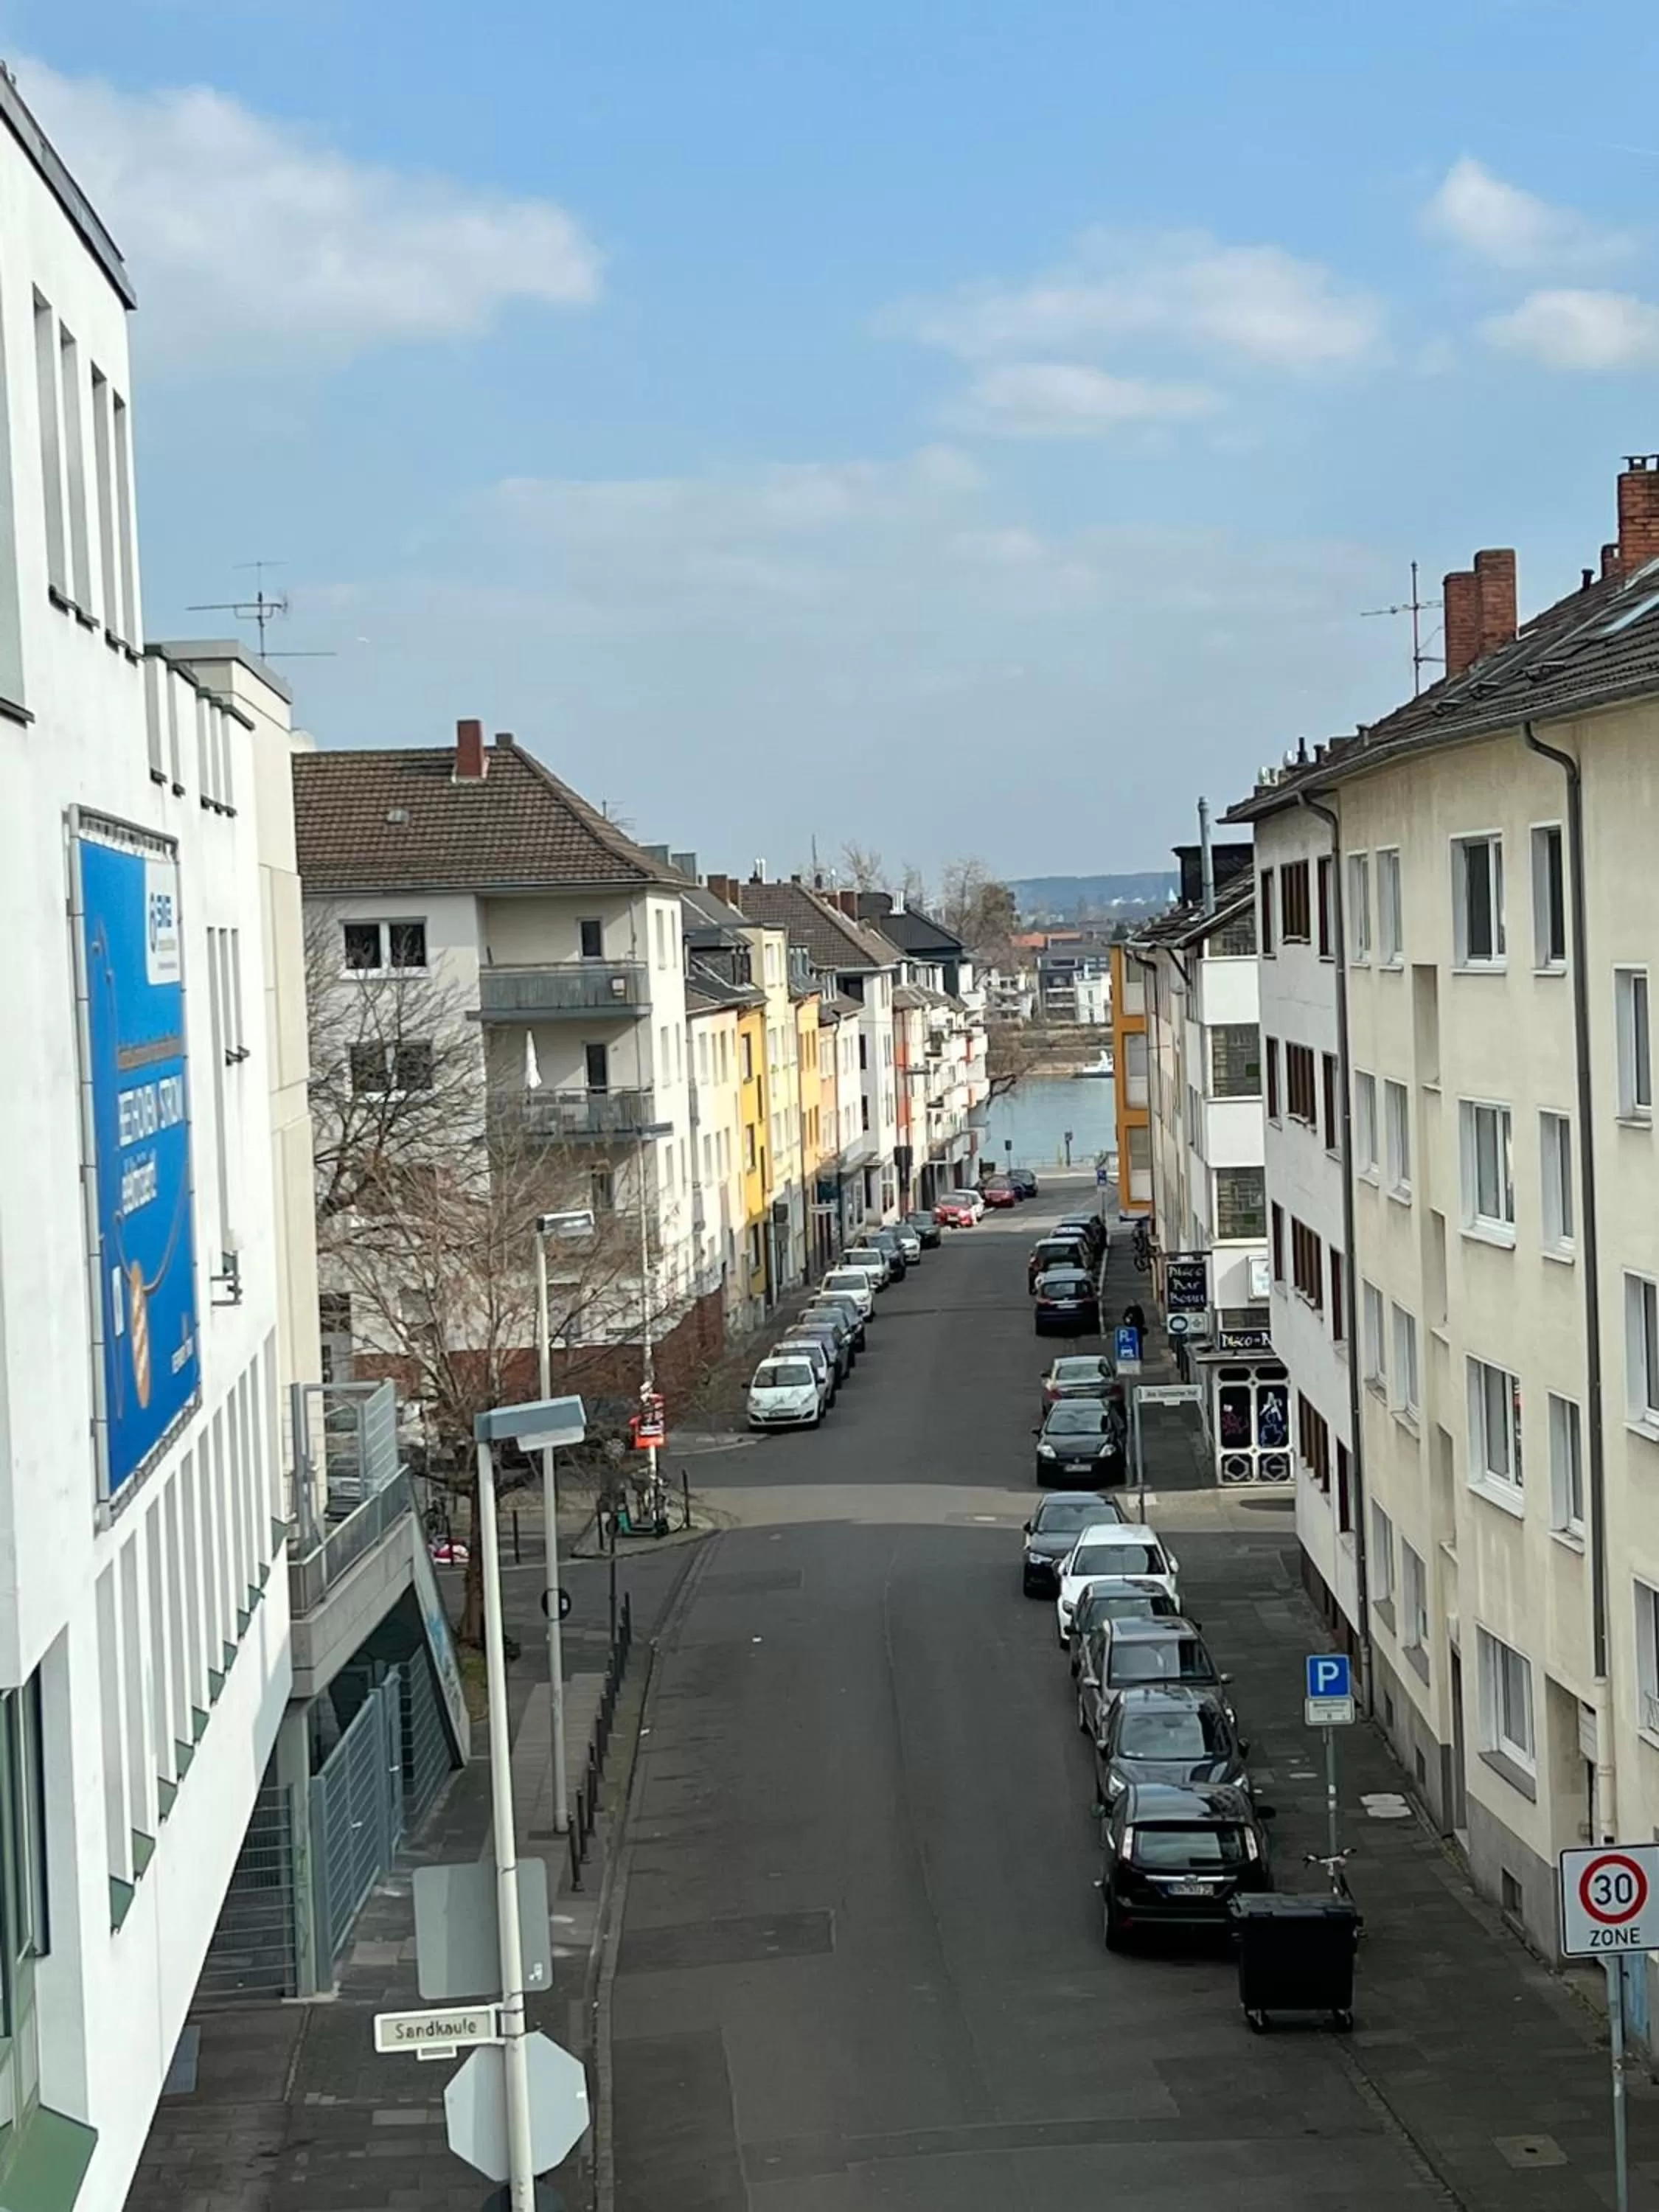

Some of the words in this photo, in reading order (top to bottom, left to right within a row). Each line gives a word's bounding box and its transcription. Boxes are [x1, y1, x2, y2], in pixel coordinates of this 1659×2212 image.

[1318, 1661, 1340, 1692] P
[1593, 1873, 1633, 1905] 30
[1589, 1927, 1641, 1947] ZONE
[394, 2017, 478, 2040] Sandkaule
